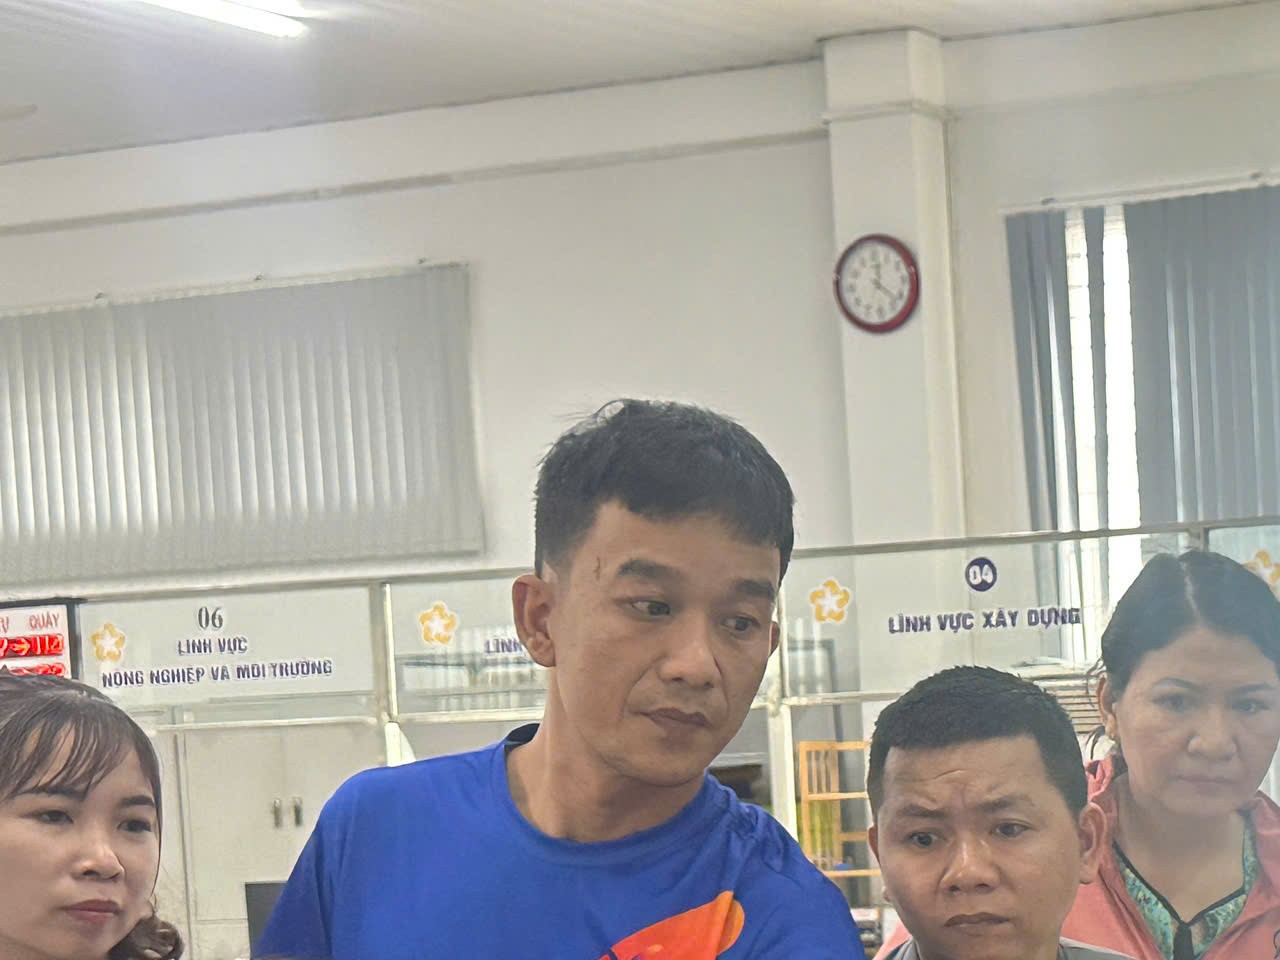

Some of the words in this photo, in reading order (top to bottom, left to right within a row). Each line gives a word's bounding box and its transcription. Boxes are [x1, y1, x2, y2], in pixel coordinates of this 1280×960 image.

[968, 565, 994, 586] 04
[198, 607, 224, 630] 06
[938, 611, 974, 633] VỰC
[982, 607, 1019, 629] XÂY
[1027, 607, 1081, 630] DỰNG
